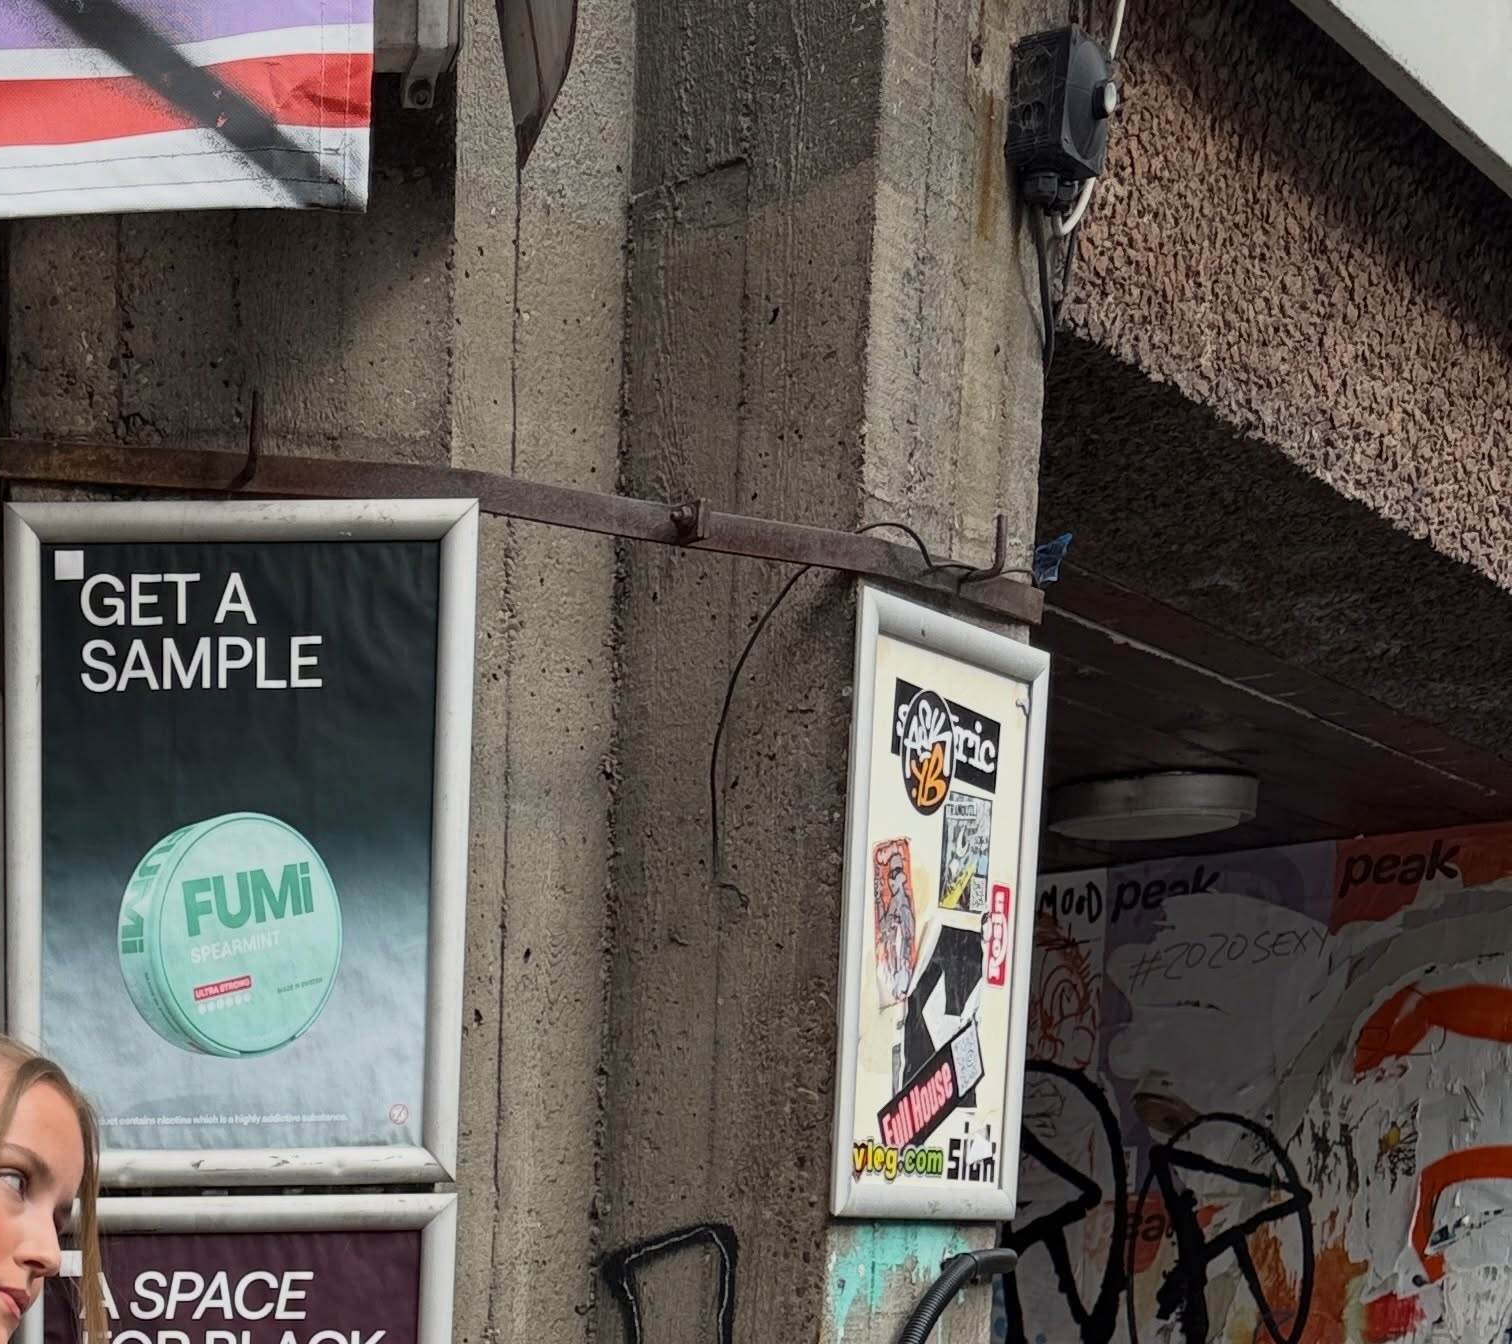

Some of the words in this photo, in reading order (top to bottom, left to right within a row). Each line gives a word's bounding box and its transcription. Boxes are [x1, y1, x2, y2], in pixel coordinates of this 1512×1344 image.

[81, 571, 201, 627] GET
[215, 571, 258, 626] A
[80, 634, 323, 693] SAMPLE
[1339, 839, 1461, 899] peak
[181, 860, 315, 938] FUMi
[190, 930, 282, 965] SPEARMINT
[909, 1061, 955, 1134] House
[130, 1270, 315, 1321] SPACE
